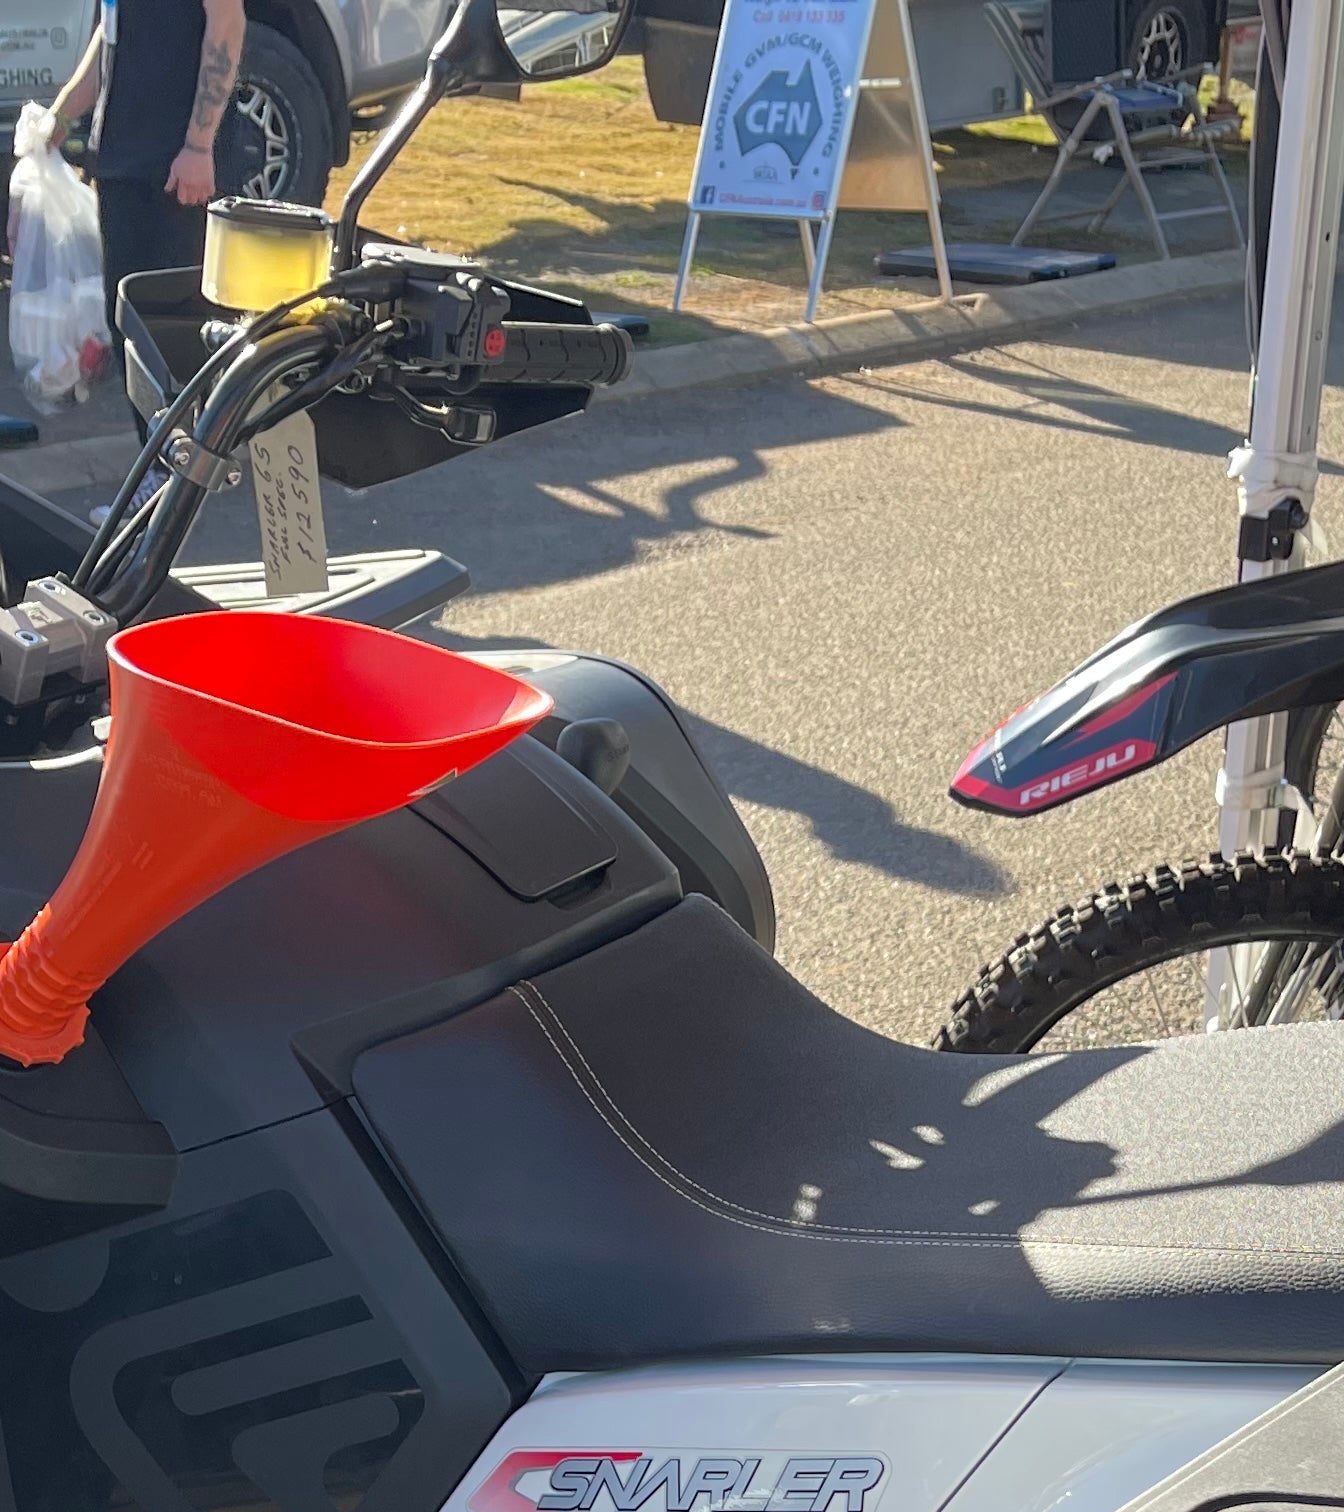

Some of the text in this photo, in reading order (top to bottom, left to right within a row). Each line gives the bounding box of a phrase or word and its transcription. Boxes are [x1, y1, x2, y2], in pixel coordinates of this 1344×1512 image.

[744, 100, 812, 136] CFN
[820, 47, 845, 159] WEIGHING
[1020, 744, 1136, 805] RIEJU
